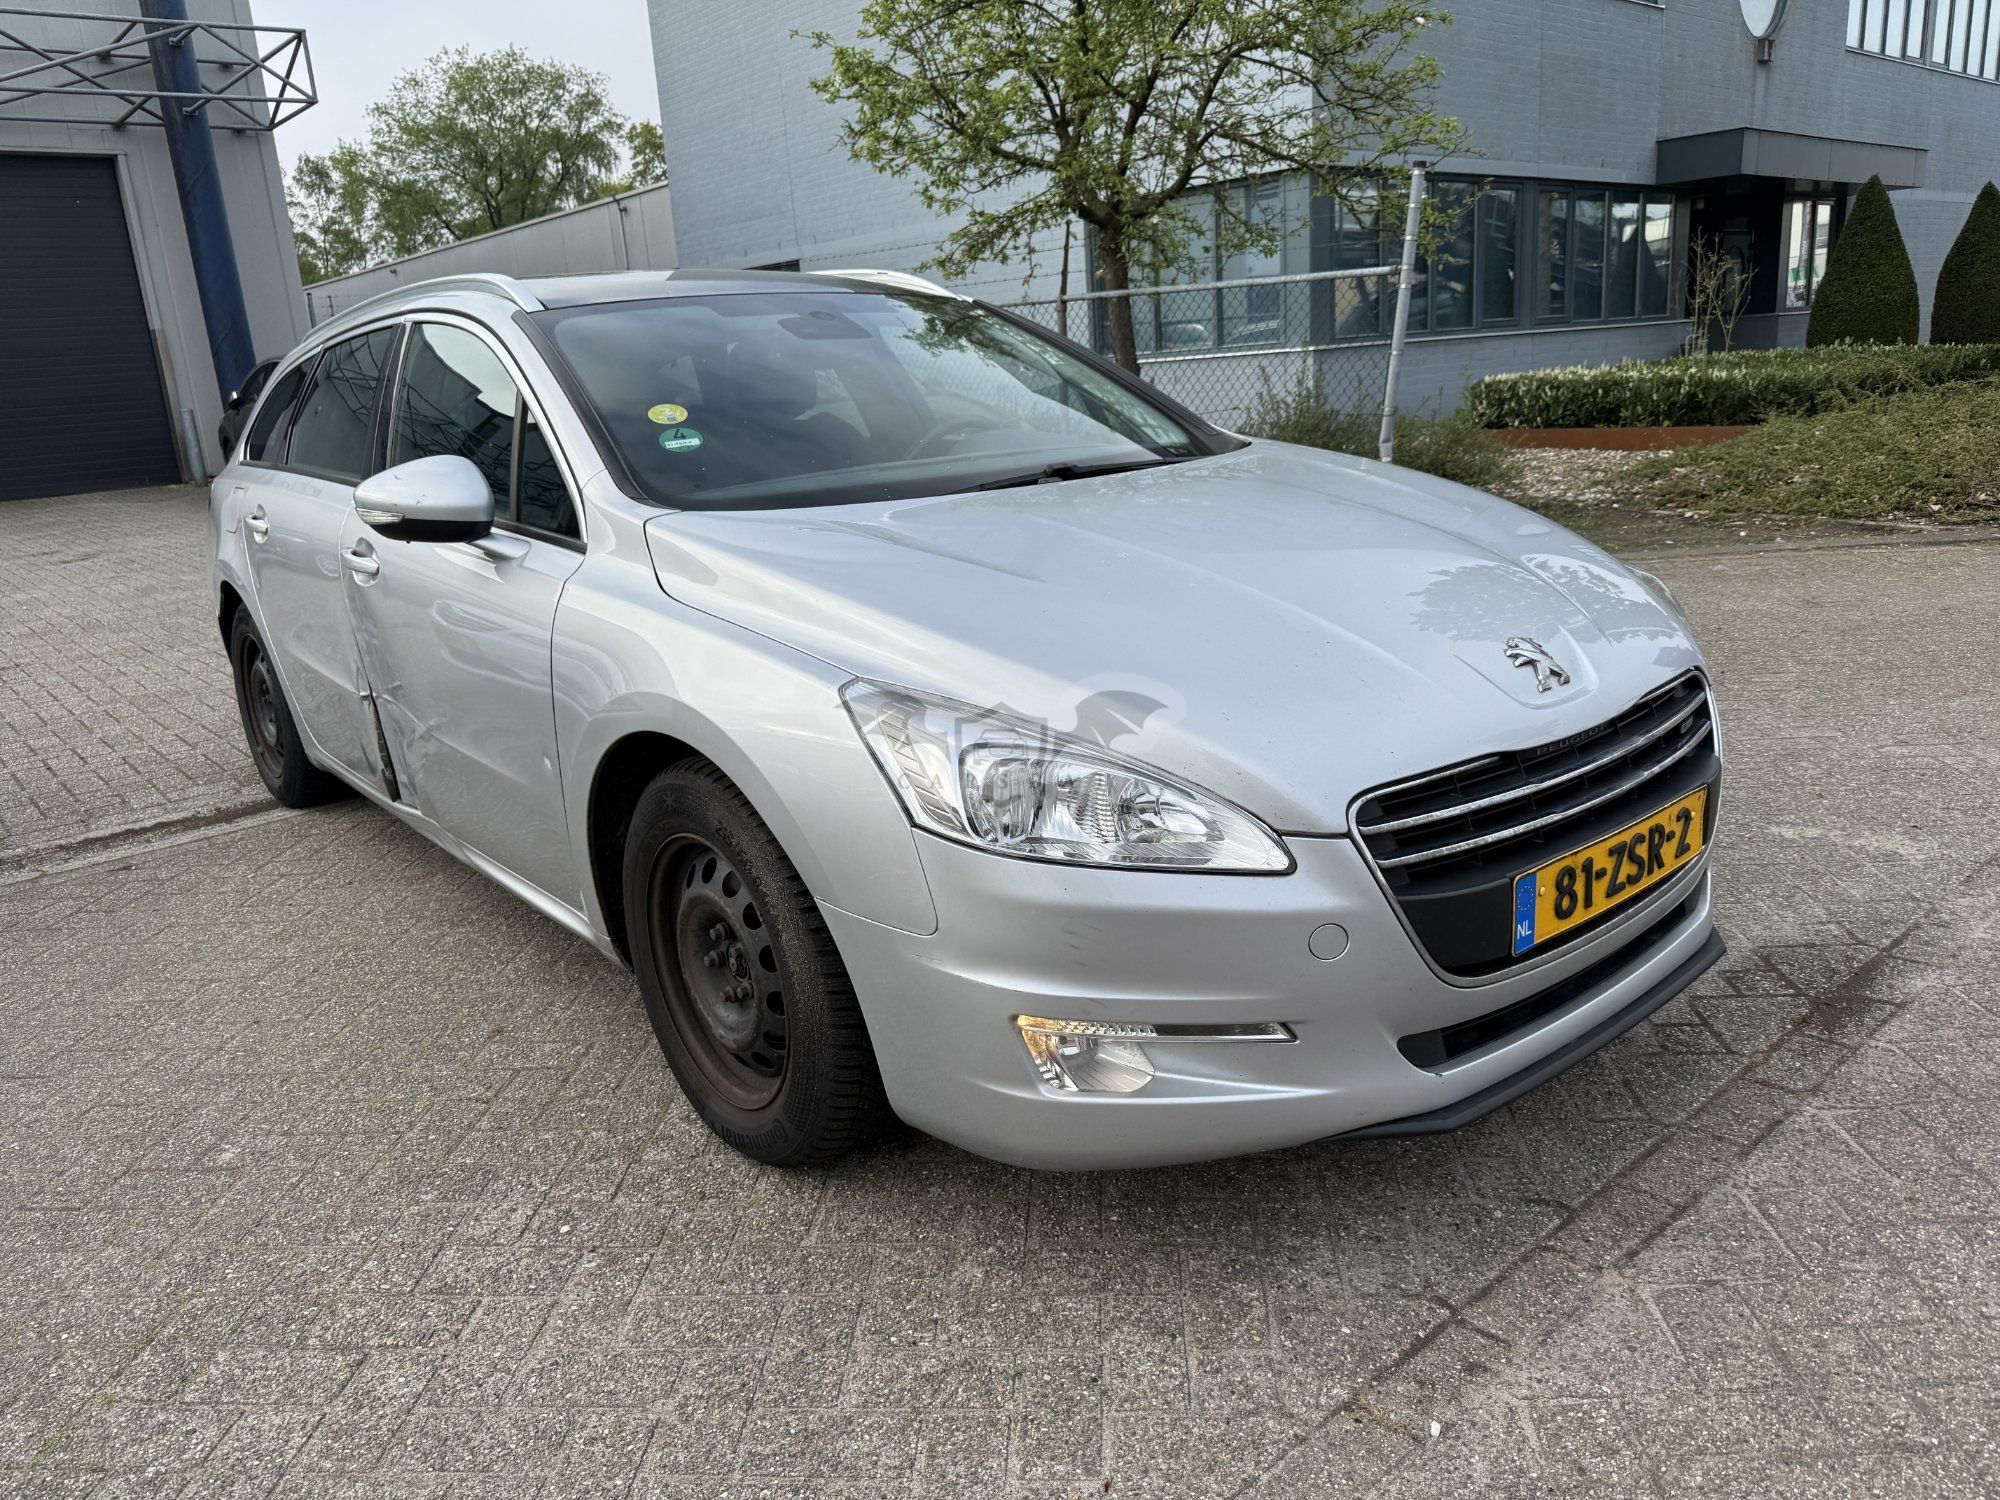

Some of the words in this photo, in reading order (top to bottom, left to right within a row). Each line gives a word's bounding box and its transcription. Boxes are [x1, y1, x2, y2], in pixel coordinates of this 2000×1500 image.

[674, 428, 687, 440] 4
[1536, 724, 1606, 756] PEUGEOT
[1553, 806, 1693, 920] 81-ZSR-2
[1516, 921, 1532, 940] NL
